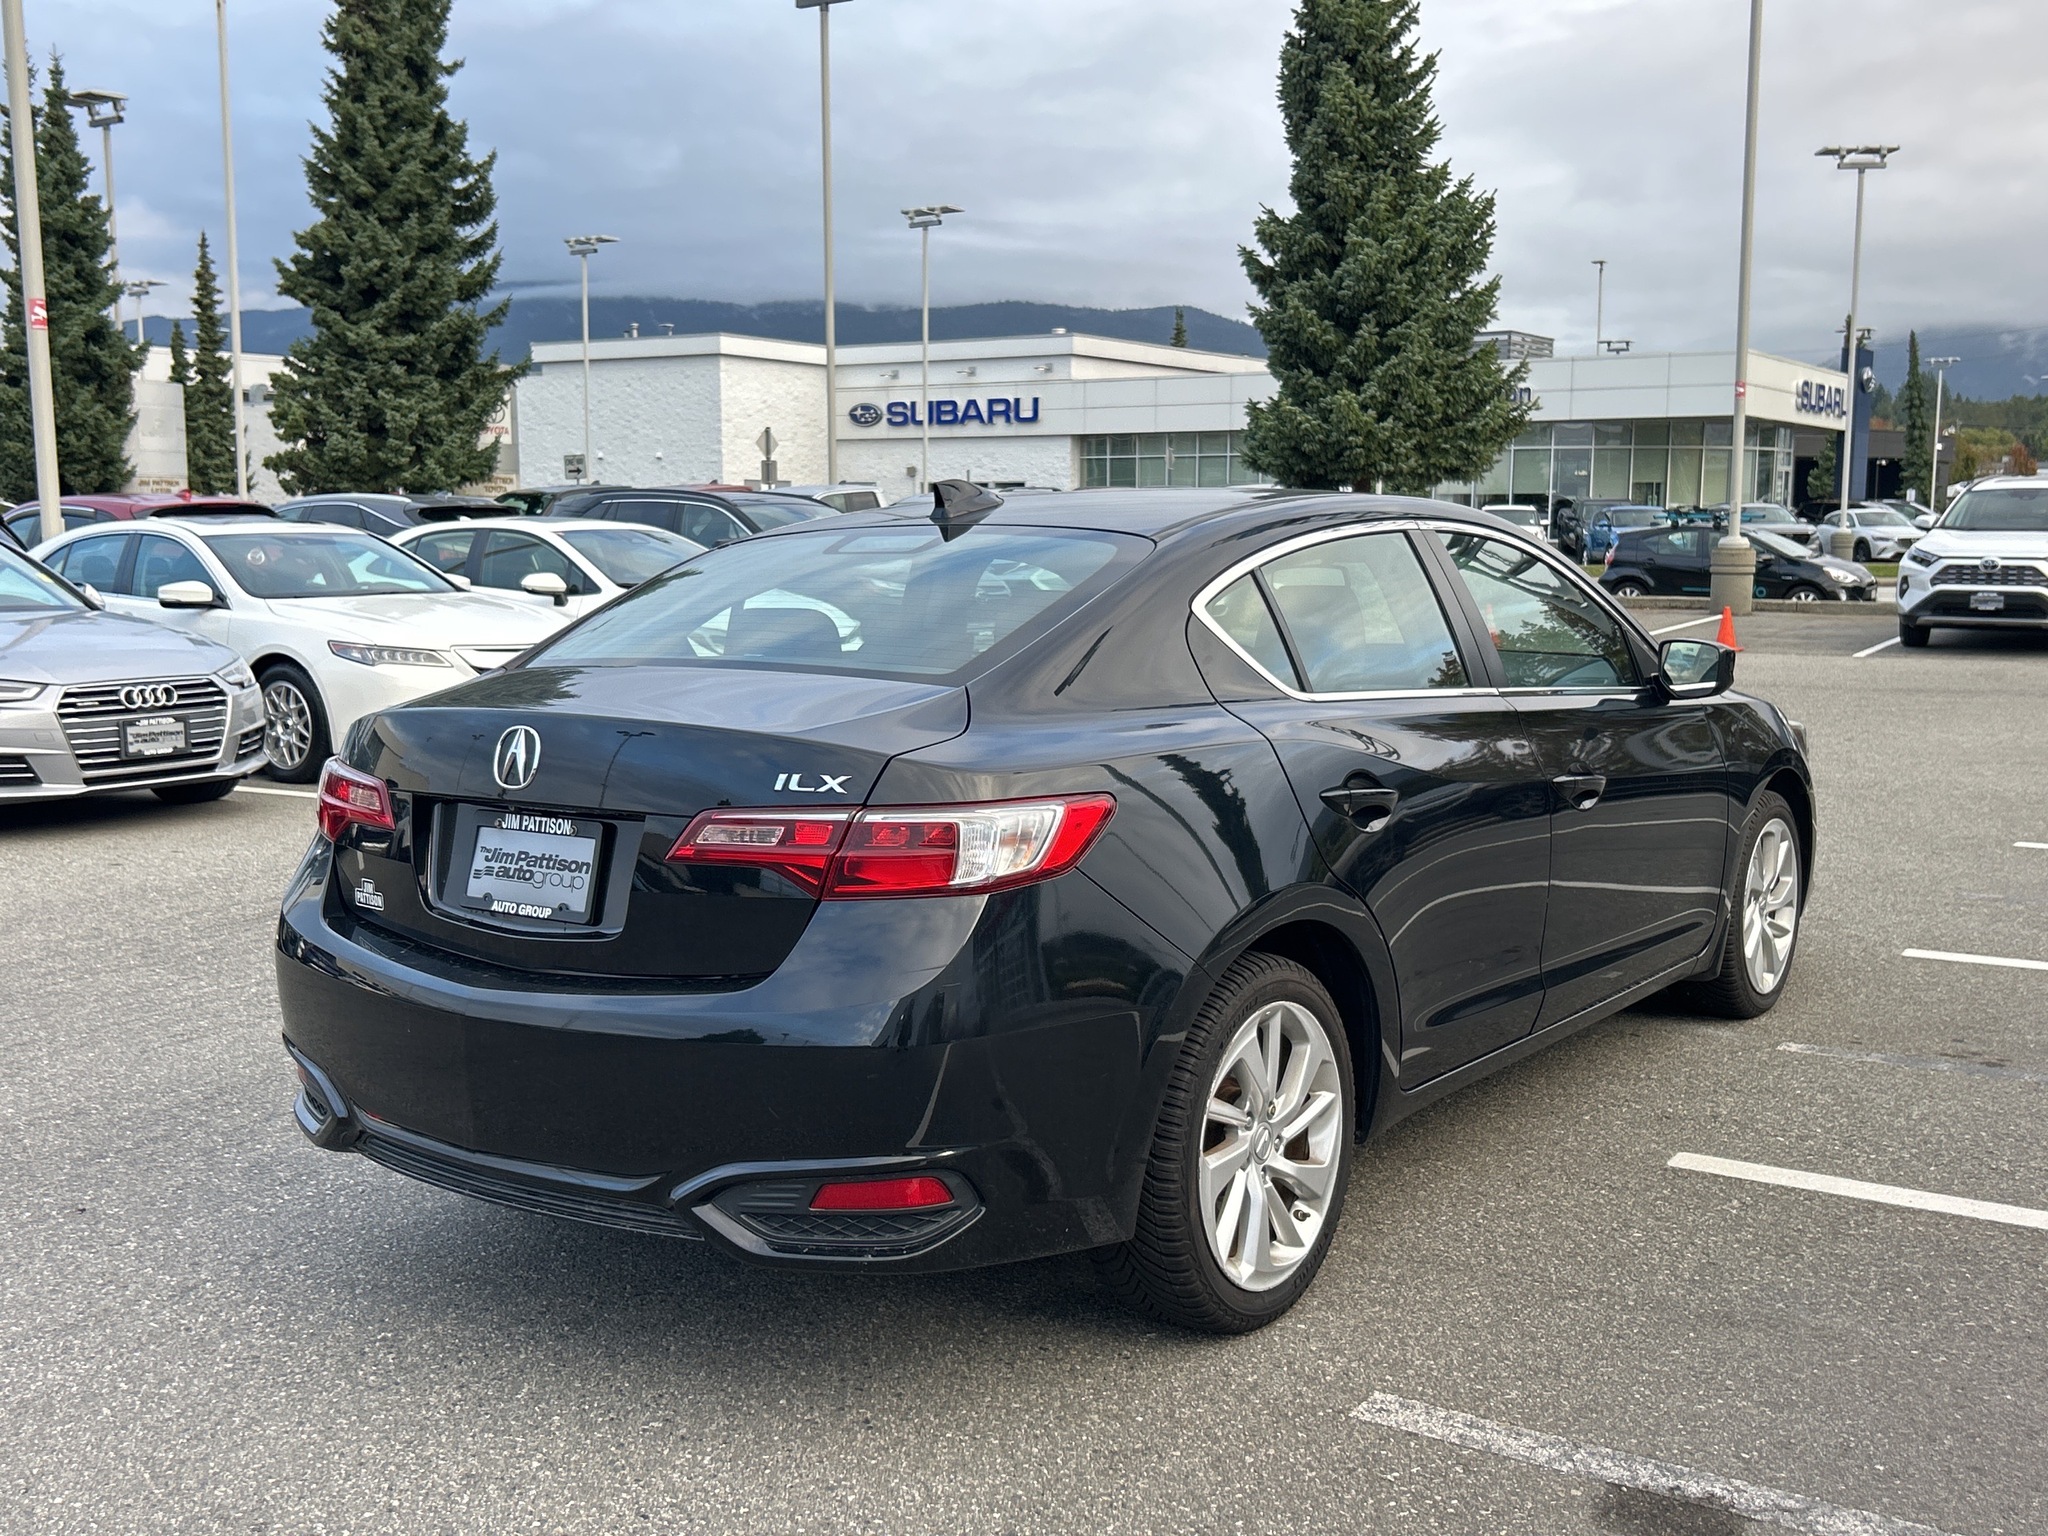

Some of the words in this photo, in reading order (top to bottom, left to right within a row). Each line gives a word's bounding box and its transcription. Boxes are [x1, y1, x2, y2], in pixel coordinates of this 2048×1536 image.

[886, 397, 1040, 426] SUBARU
[480, 426, 510, 435] OYOTA
[774, 773, 852, 794] ILX
[502, 813, 521, 830] JIM
[522, 816, 572, 836] PATTISON
[480, 846, 493, 854] The
[357, 890, 382, 908] PATTISON
[491, 900, 517, 915] AUTO
[518, 904, 552, 918] GROUP
